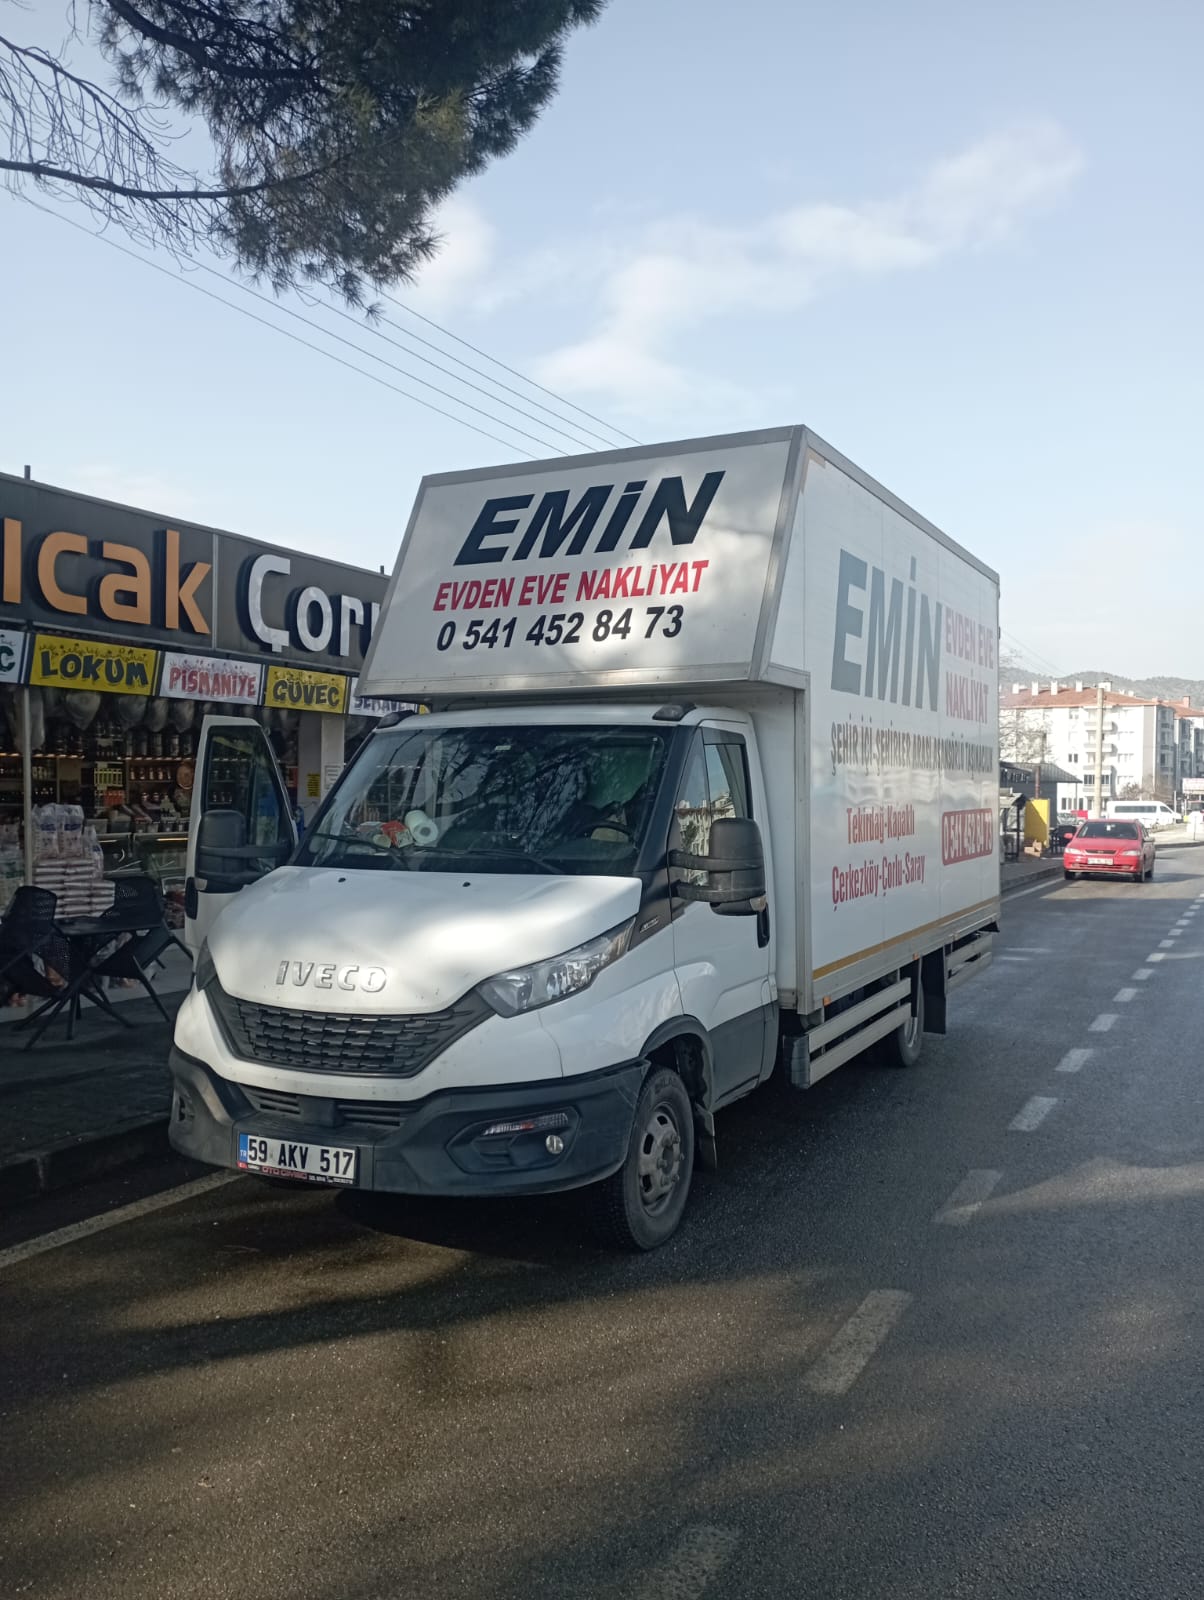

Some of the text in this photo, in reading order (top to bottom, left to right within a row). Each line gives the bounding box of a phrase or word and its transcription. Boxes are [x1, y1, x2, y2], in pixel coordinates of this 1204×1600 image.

[432, 576, 516, 612] EVDEN
[517, 572, 570, 607] EVE
[436, 604, 684, 651] 0 541 452 84 73
[945, 606, 994, 670] EVDEN EVE
[41, 650, 149, 686] LOKUM
[830, 712, 859, 776] ŞEHİR
[275, 960, 388, 993] IVECO
[248, 1138, 268, 1163] 59
[278, 1143, 309, 1170] AKV
[320, 1148, 354, 1176] 517
